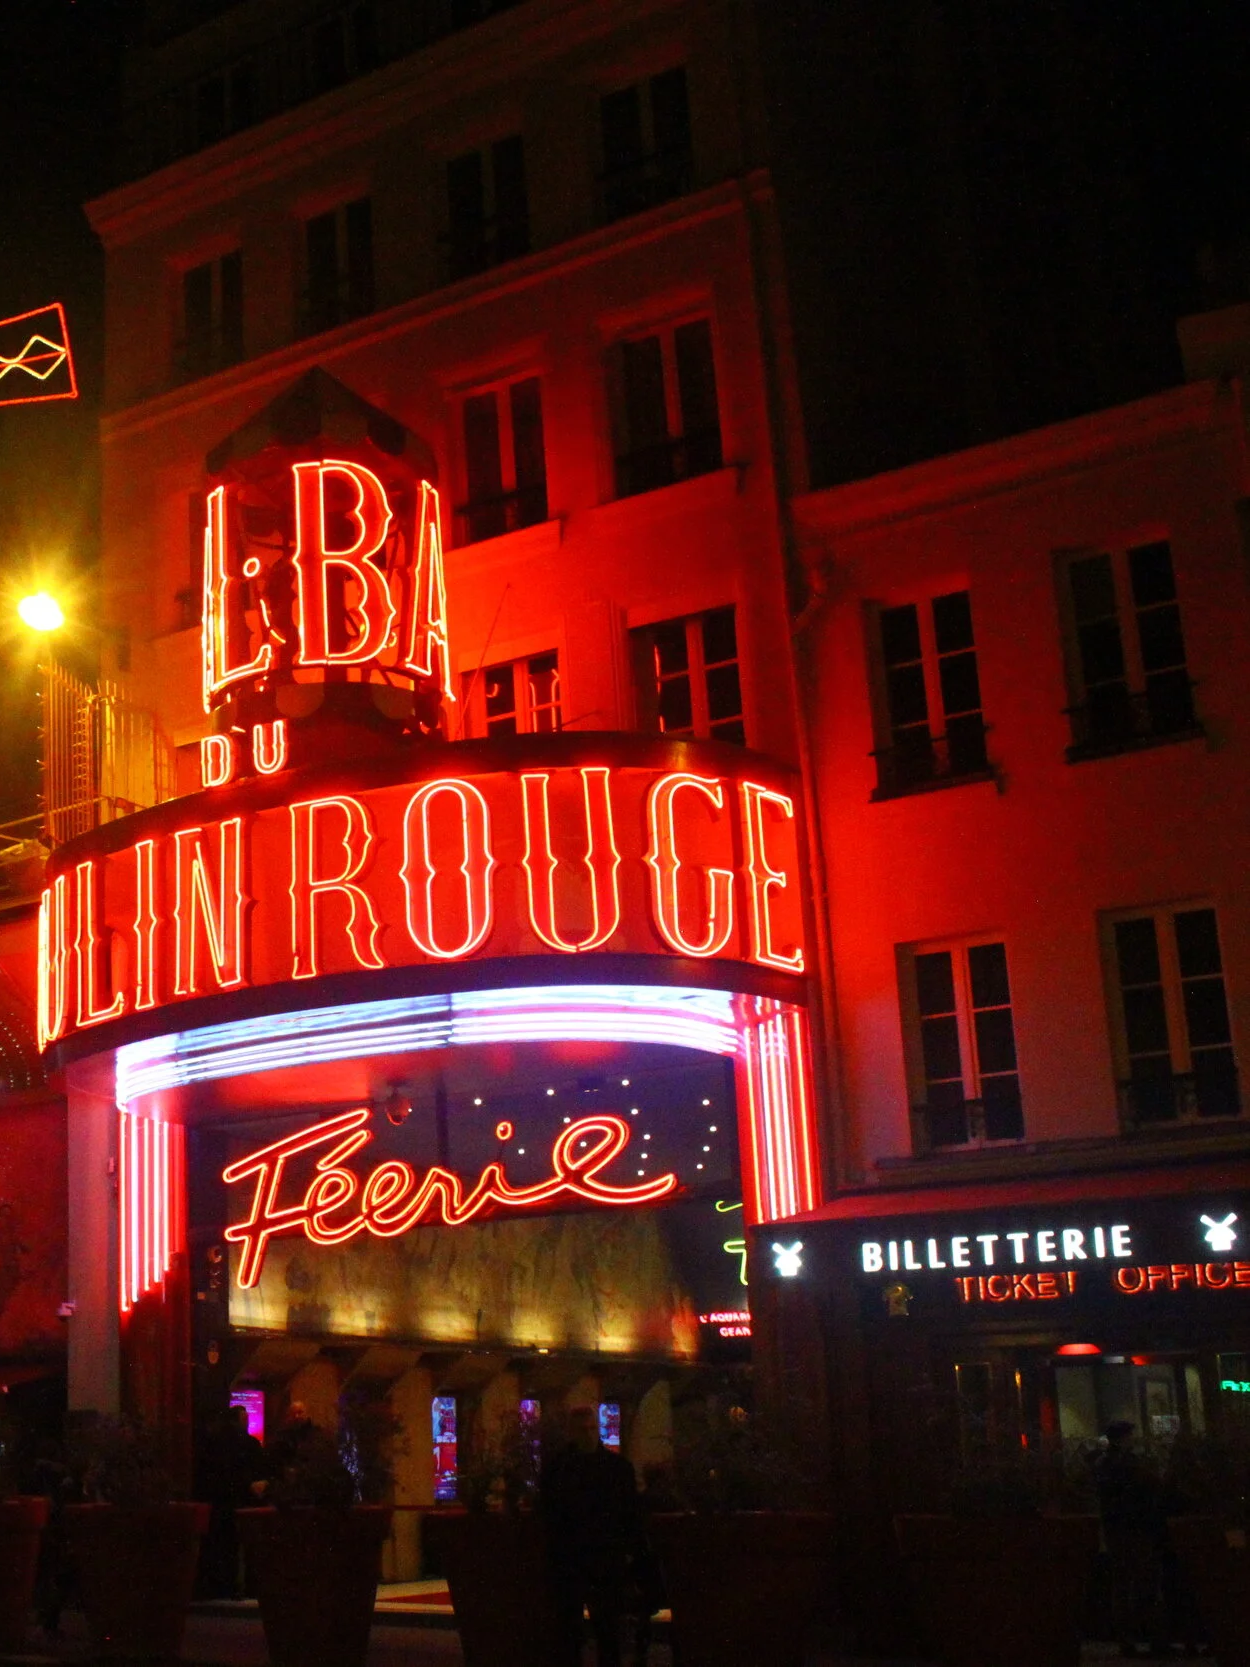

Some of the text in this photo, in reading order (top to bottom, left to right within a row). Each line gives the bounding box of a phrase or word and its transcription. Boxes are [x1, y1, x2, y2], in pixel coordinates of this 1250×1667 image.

[201, 720, 285, 787] DU
[37, 766, 805, 1055] ULIN ROUGE
[223, 1108, 677, 1288] Féerie
[861, 1223, 1133, 1273] BILLETTERIE
[955, 1261, 1250, 1303] TICKET OFFICE
